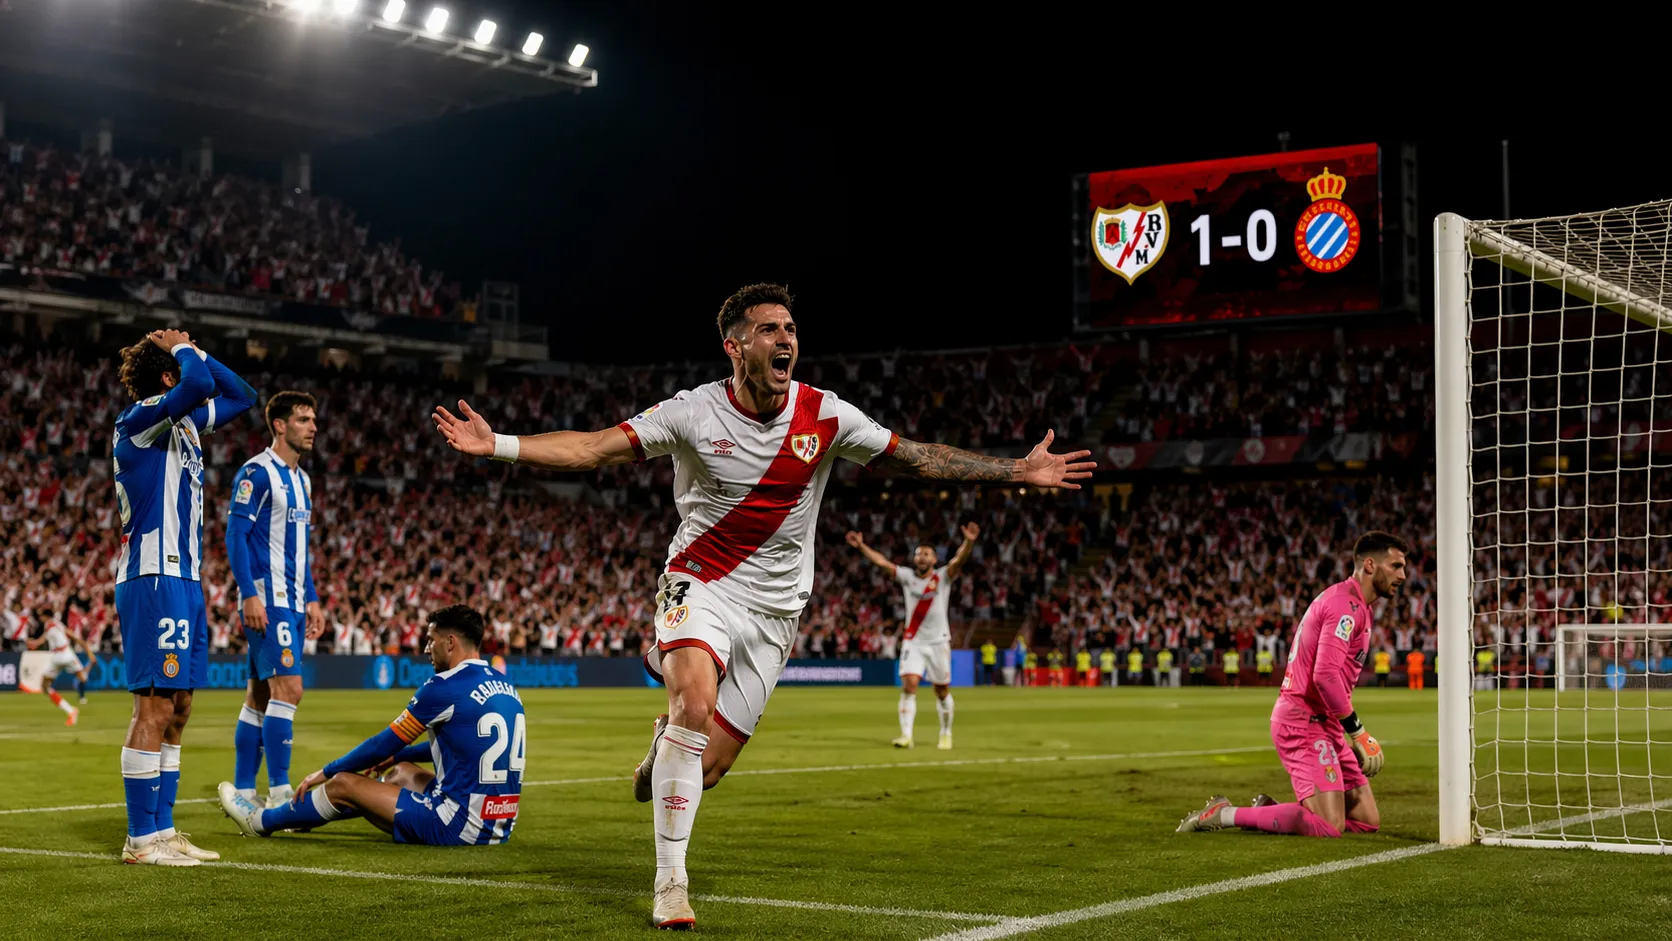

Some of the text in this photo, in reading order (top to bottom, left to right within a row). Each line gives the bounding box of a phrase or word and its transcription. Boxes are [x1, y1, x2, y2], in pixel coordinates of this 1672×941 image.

[1191, 208, 1278, 266] 1-0
[158, 617, 190, 650] 23
[276, 621, 293, 647] 6
[477, 712, 526, 785] 24
